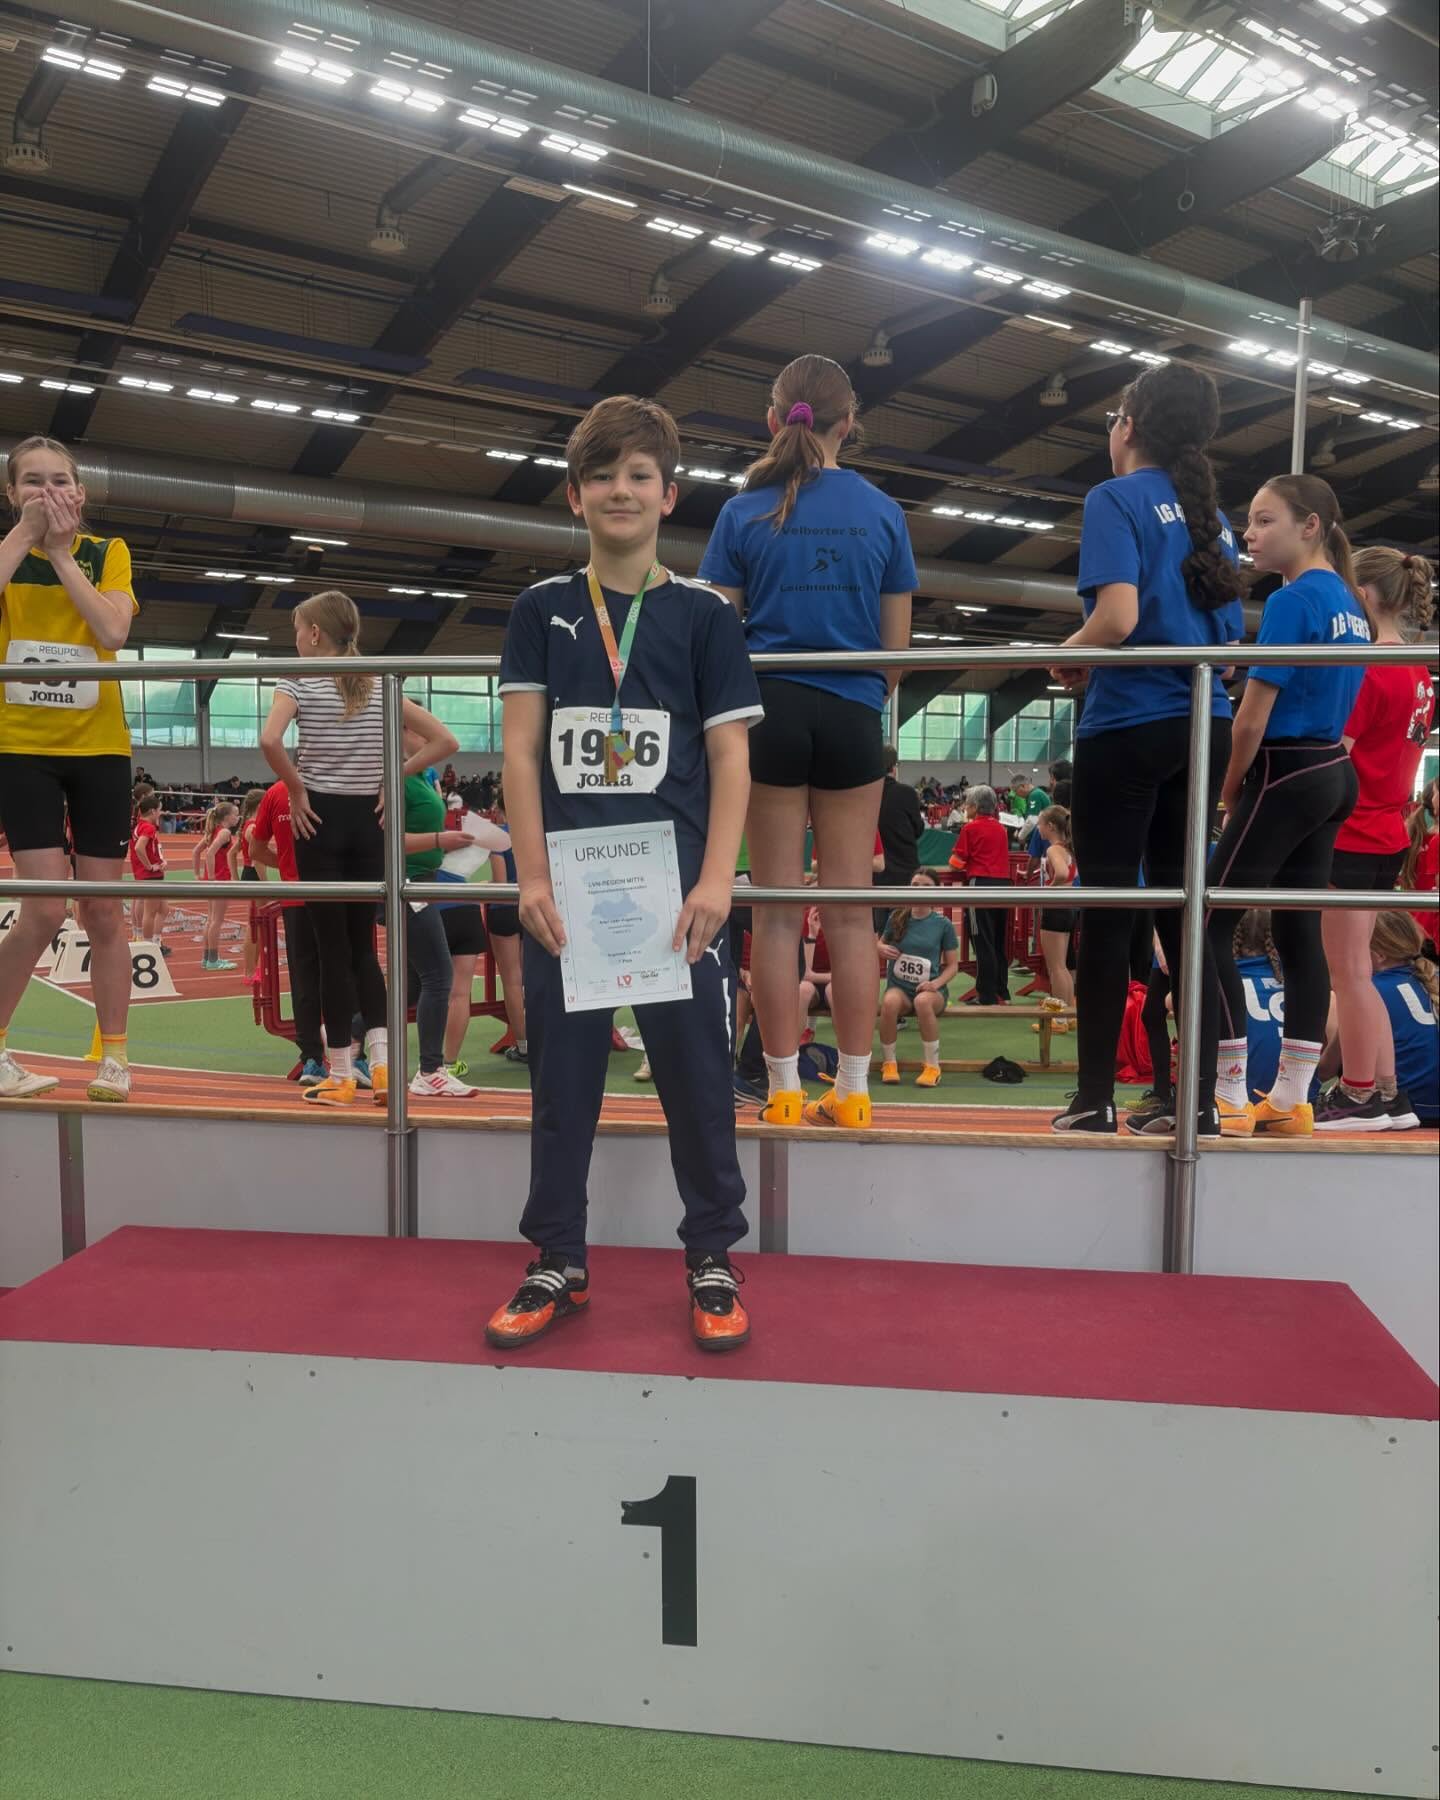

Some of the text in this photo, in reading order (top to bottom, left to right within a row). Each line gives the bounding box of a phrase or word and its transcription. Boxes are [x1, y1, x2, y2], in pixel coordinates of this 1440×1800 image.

[39, 645, 81, 657] REGUPOL
[29, 690, 75, 704] Joma
[590, 712, 643, 723] REGPOL
[559, 729, 660, 767] 196
[575, 841, 651, 862] URKUNDE
[132, 953, 159, 989] 8
[900, 960, 923, 975] 363
[621, 1475, 697, 1647] 1
